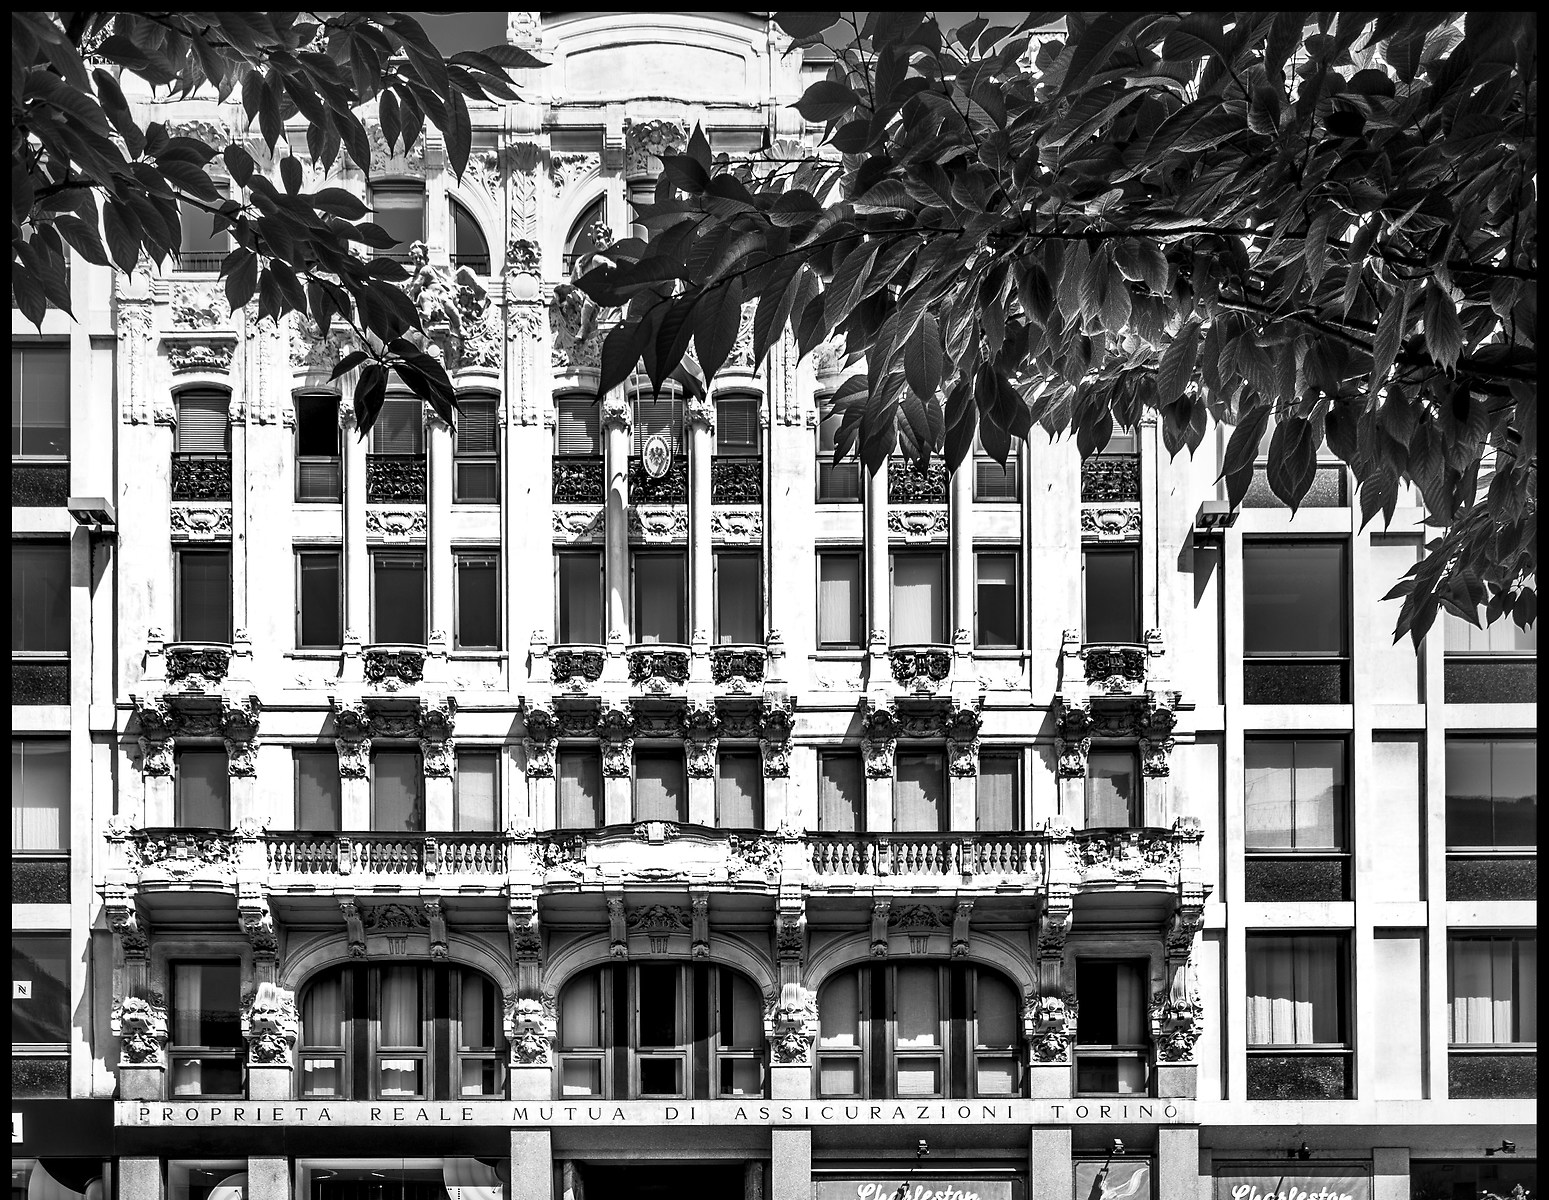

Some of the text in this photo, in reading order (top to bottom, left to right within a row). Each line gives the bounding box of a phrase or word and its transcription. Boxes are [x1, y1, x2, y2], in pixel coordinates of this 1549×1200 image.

[370, 1107, 473, 1121] REALE
[513, 1107, 625, 1121] MUTUA
[665, 1106, 695, 1120] DI
[734, 1105, 1012, 1120] ASSICURAZIONI
[1051, 1105, 1177, 1119] TORINO
